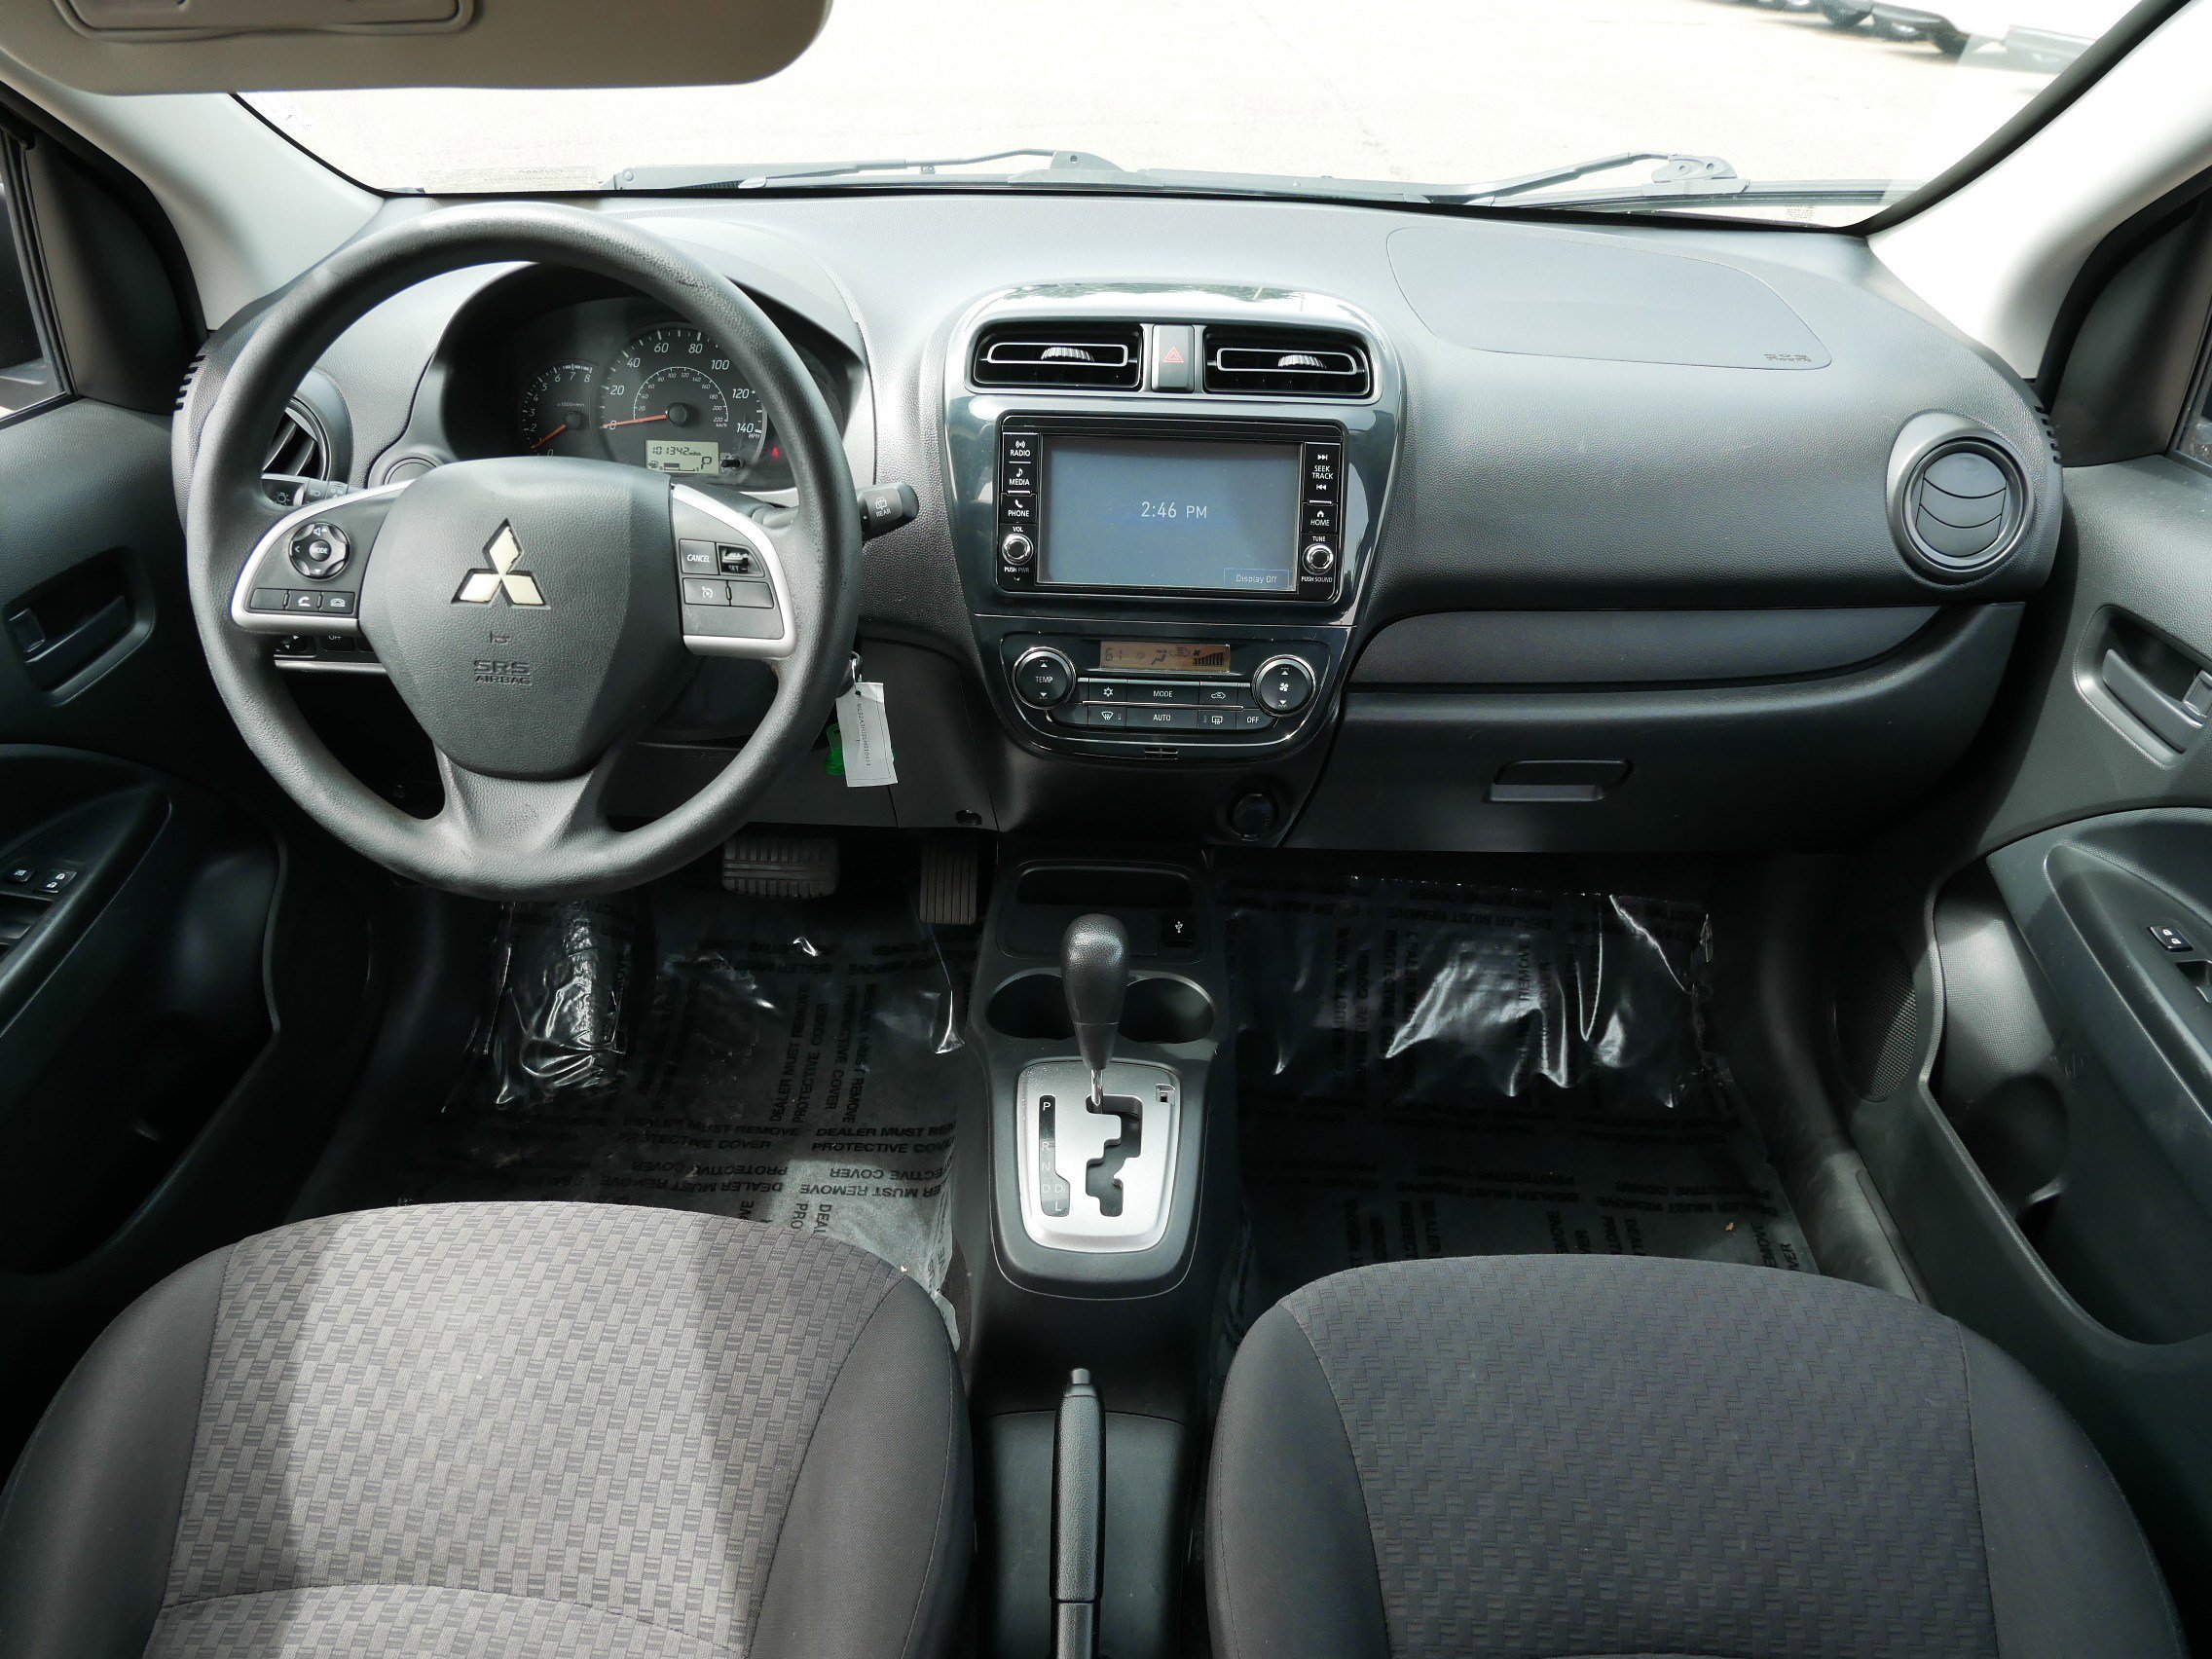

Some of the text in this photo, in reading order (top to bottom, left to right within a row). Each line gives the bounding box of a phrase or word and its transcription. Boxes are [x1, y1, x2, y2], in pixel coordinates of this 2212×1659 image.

[654, 343, 669, 352] 60
[688, 344, 703, 353] 80
[627, 357, 641, 368] 40
[711, 360, 730, 370] 100
[584, 374, 590, 383] 8
[610, 386, 624, 395] 20
[732, 388, 749, 399] 120
[736, 423, 754, 433] 140
[652, 447, 689, 456] 101342
[701, 456, 712, 470] P
[876, 508, 891, 518] REAR
[1141, 501, 1207, 519] 2:46 PM
[1310, 518, 1330, 527] HOME
[687, 554, 710, 563] CANCEL
[1235, 573, 1277, 584] Display Off
[474, 661, 531, 674] SRS
[1246, 716, 1259, 724] OFF
[770, 982, 810, 1123] DEALER MUST REMOVE
[793, 1003, 828, 1123] PROTECTIVE COVER
[826, 1069, 844, 1110] COVER
[843, 1076, 865, 1123] REMOVE
[1042, 1102, 1051, 1111] P
[687, 1121, 731, 1134] MUST
[735, 1124, 799, 1137] REMOVE
[816, 1127, 876, 1137] DEALER
[880, 1126, 924, 1137] MUST
[719, 1139, 771, 1150] COVER
[812, 1142, 907, 1153] PROTECTIVE
[1041, 1141, 1050, 1151] R
[690, 1163, 788, 1177] PROTECTIV
[1041, 1161, 1051, 1171] N
[830, 1167, 947, 1180] ECTIVE COVER
[600, 1174, 668, 1190] REMOVE
[672, 1178, 717, 1193] MUST
[719, 1181, 783, 1193] DEALER
[799, 1183, 868, 1196] REMOVE
[871, 1185, 918, 1198] MUST
[1042, 1183, 1051, 1193] D
[1054, 1200, 1062, 1211] L
[1668, 1202, 1714, 1214] MUST
[1751, 1221, 1778, 1268] EMOVE
[1780, 1242, 1799, 1272] VER
